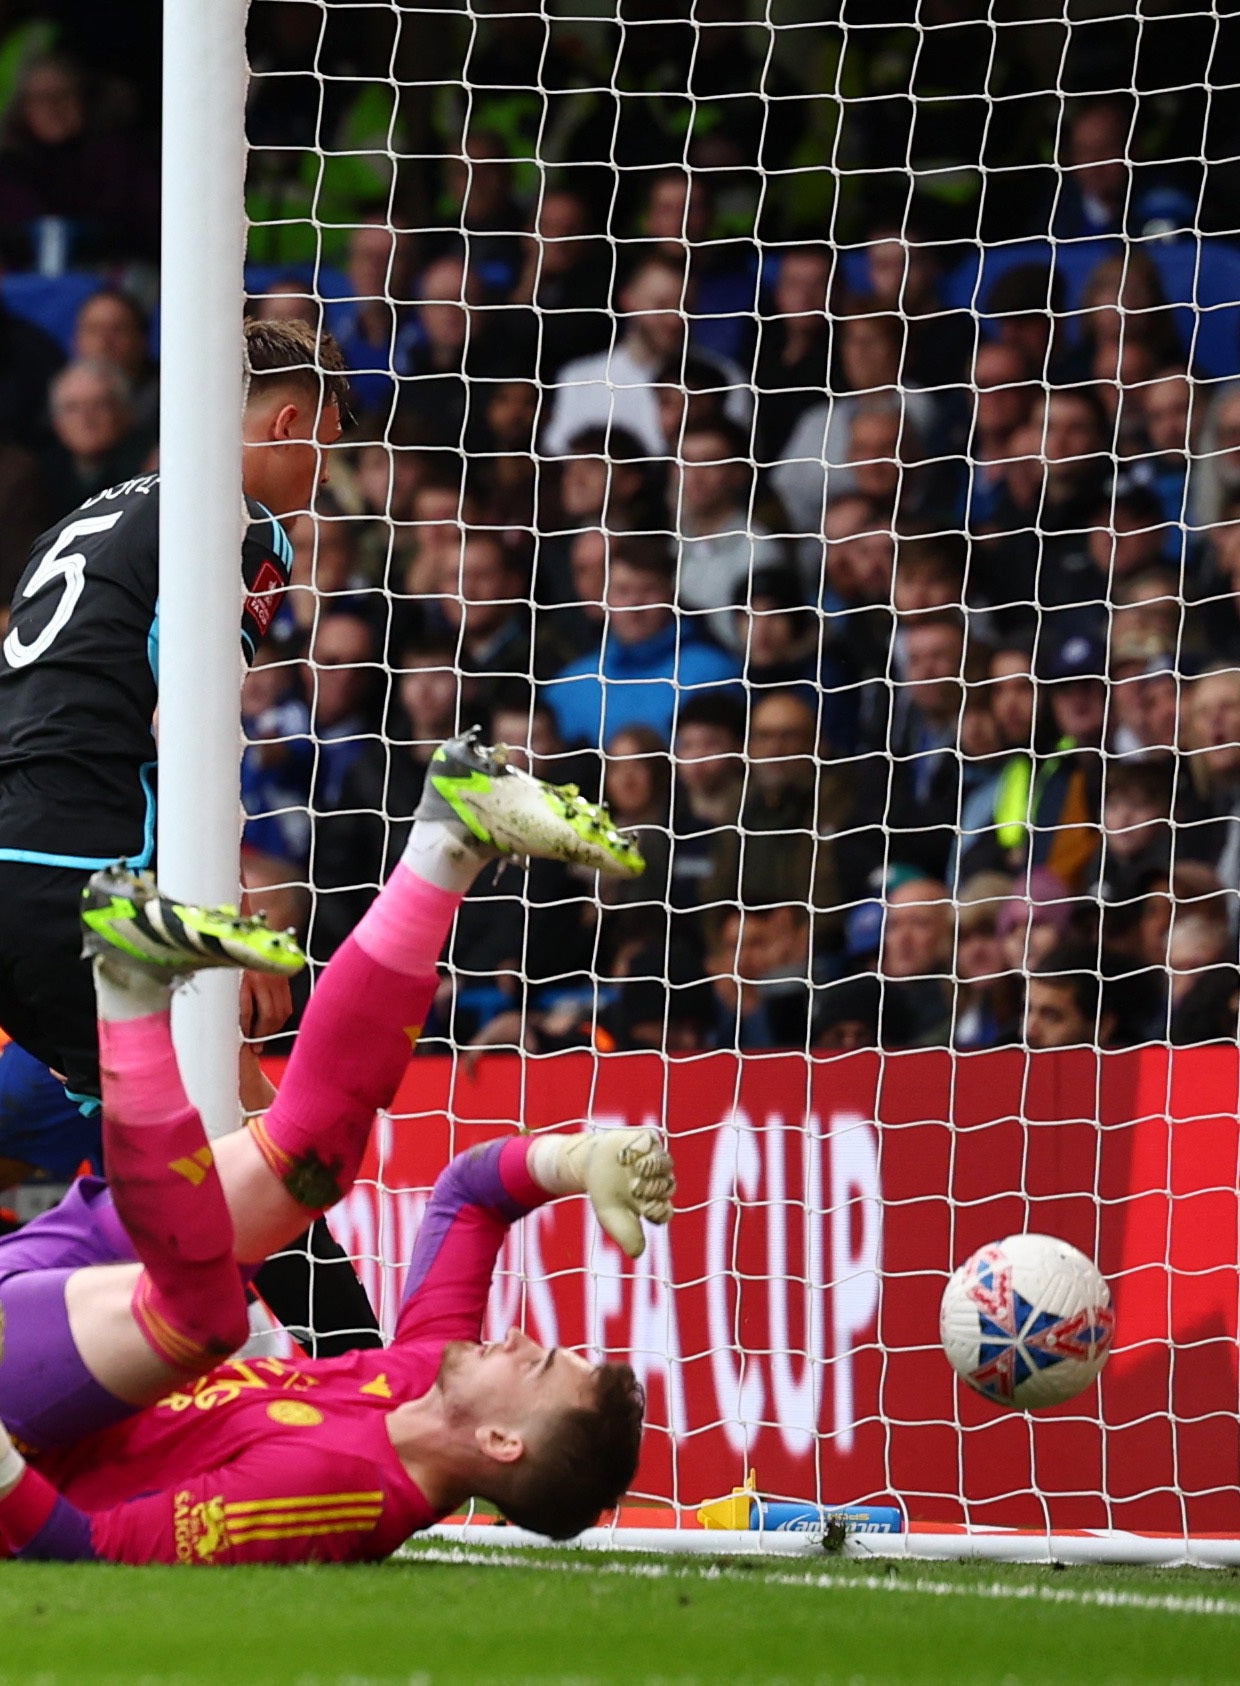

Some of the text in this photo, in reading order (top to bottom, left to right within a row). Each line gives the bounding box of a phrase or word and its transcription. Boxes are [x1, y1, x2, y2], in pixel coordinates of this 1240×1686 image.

[3, 510, 125, 669] 5
[586, 1113, 691, 1452] FA
[707, 1104, 883, 1458] CUP
